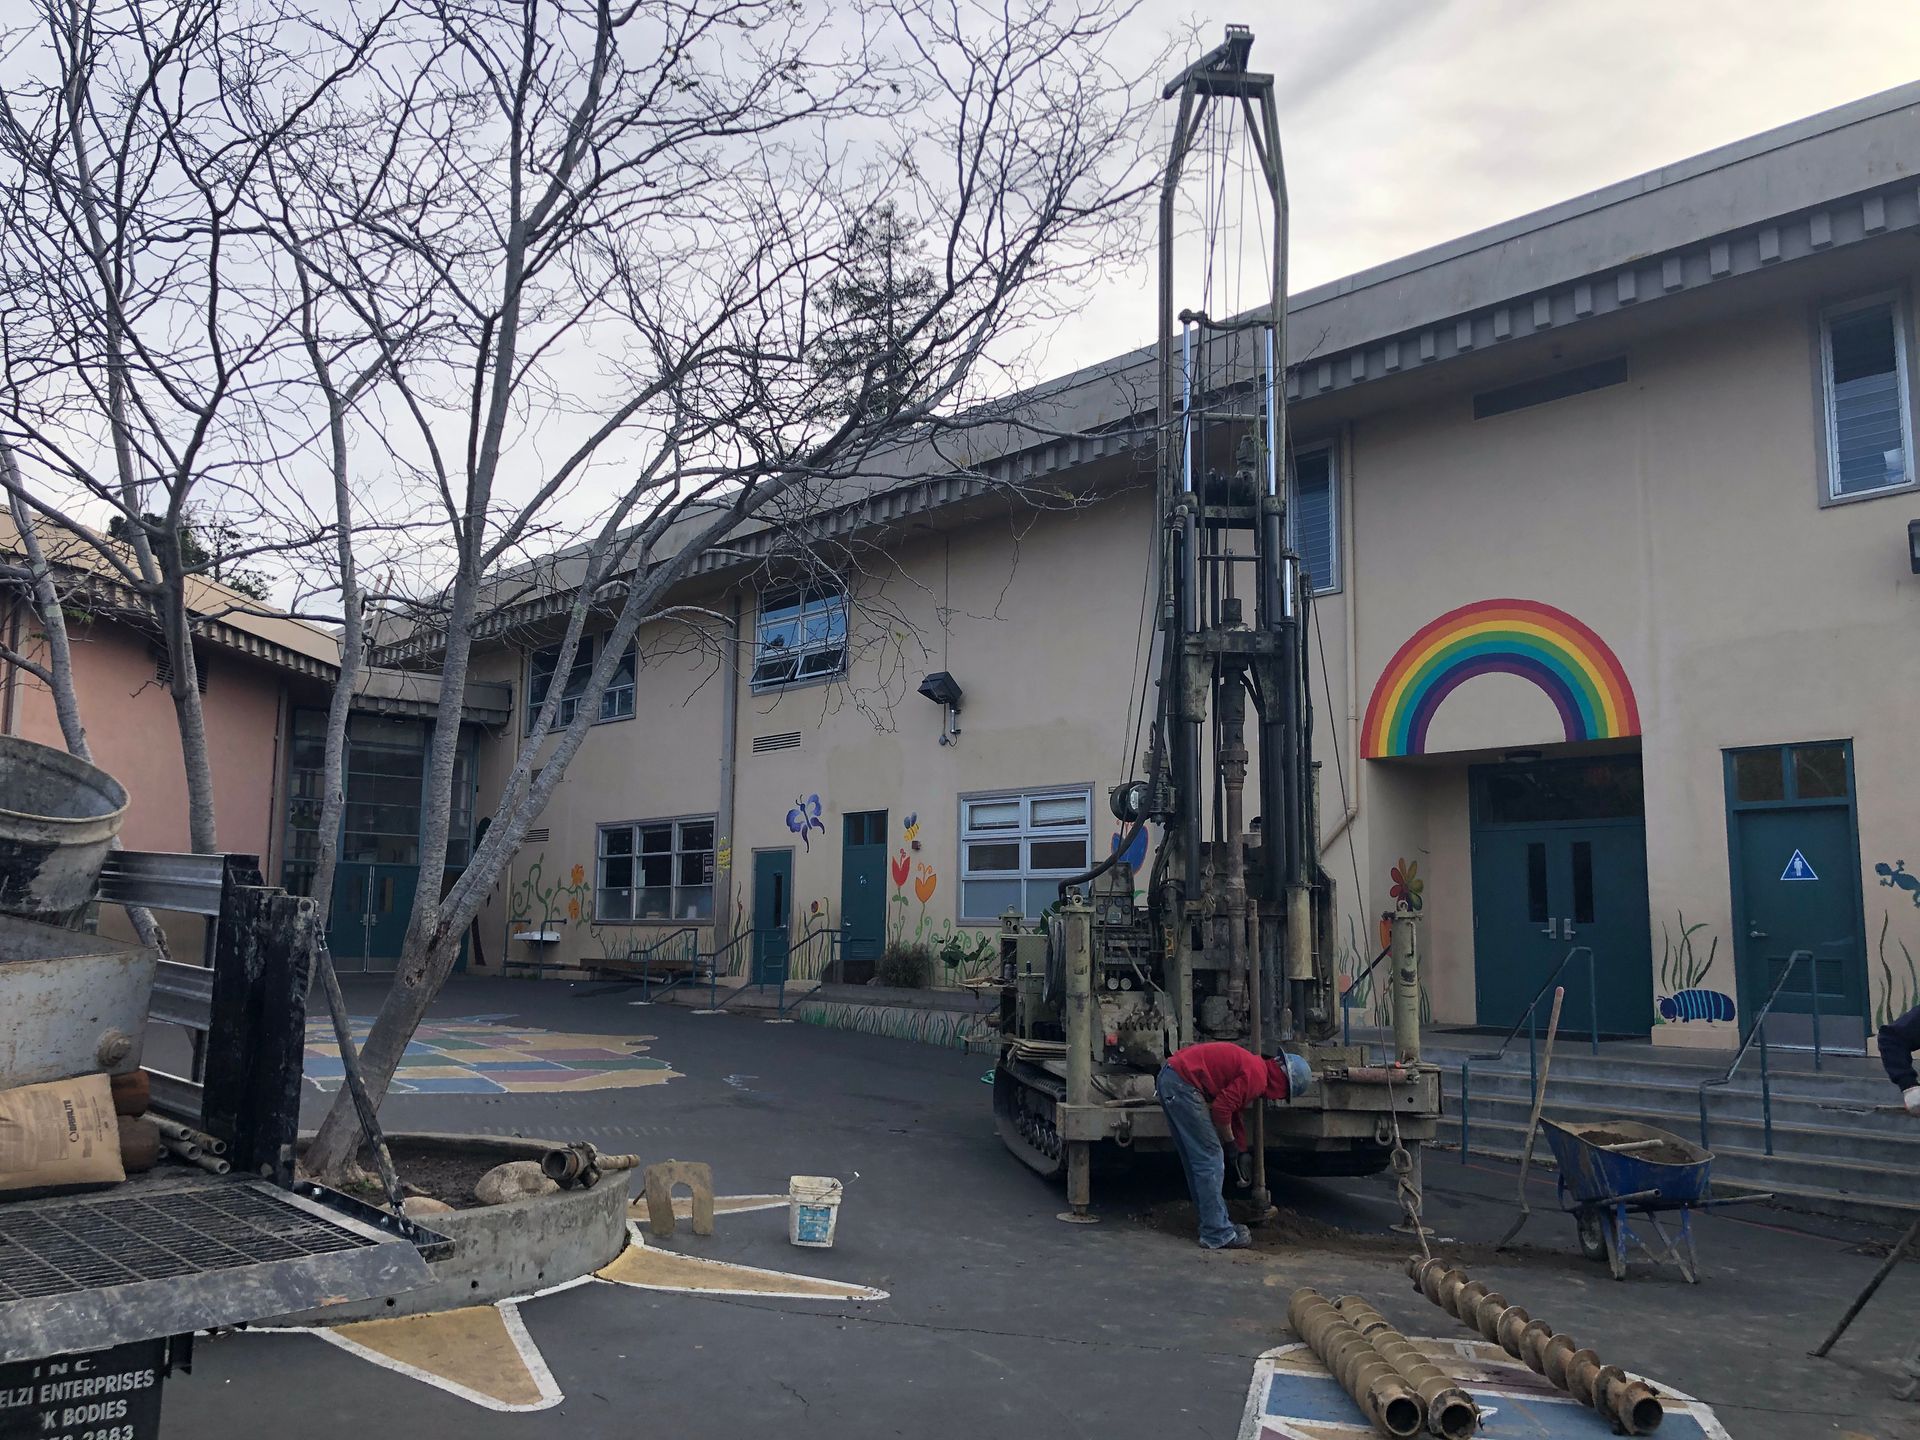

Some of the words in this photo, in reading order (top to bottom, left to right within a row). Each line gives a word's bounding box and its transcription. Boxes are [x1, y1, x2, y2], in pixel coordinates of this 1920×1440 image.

[33, 1359, 97, 1378] INC.
[40, 1369, 156, 1404] ENTERPRISES
[62, 1399, 128, 1427] BODIES
